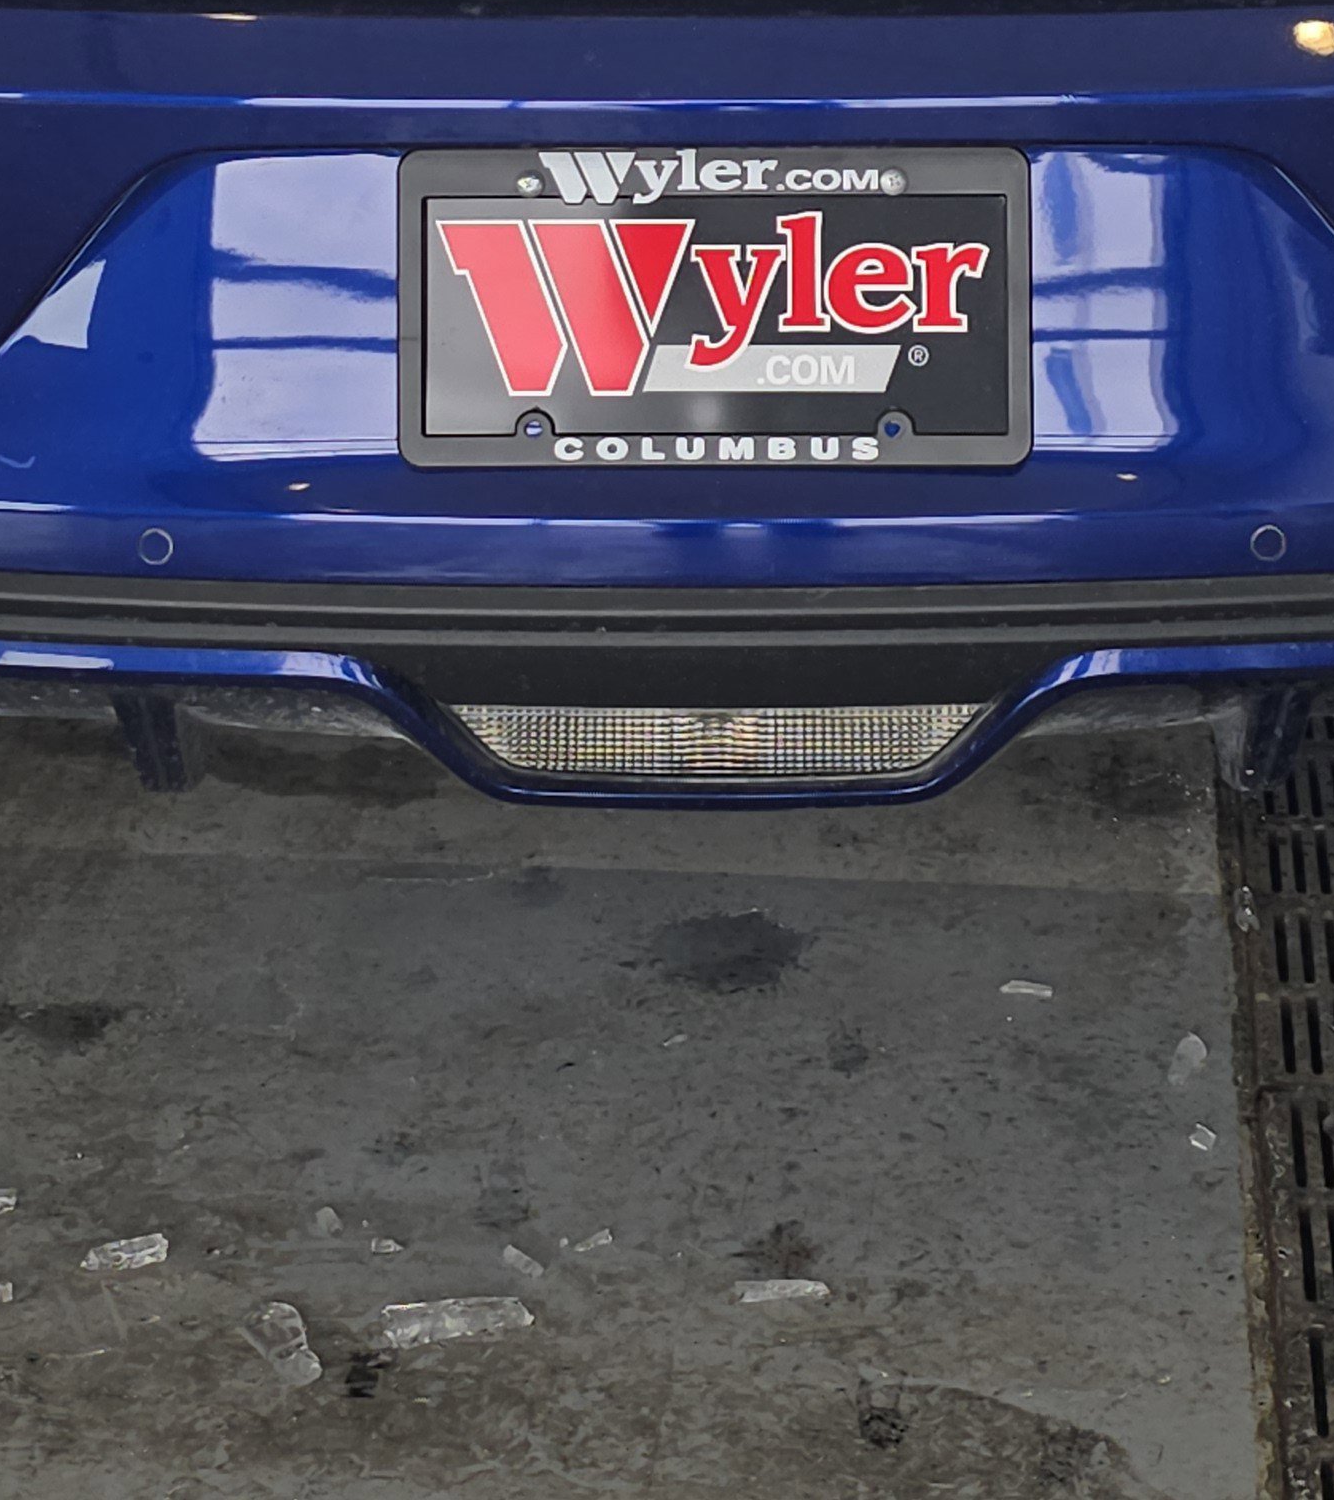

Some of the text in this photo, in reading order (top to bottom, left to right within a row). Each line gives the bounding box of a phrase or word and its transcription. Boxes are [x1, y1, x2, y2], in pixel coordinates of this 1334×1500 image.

[436, 211, 989, 396] Wyler
[756, 354, 856, 386] .COM
[554, 436, 880, 461] COLUMBUS
